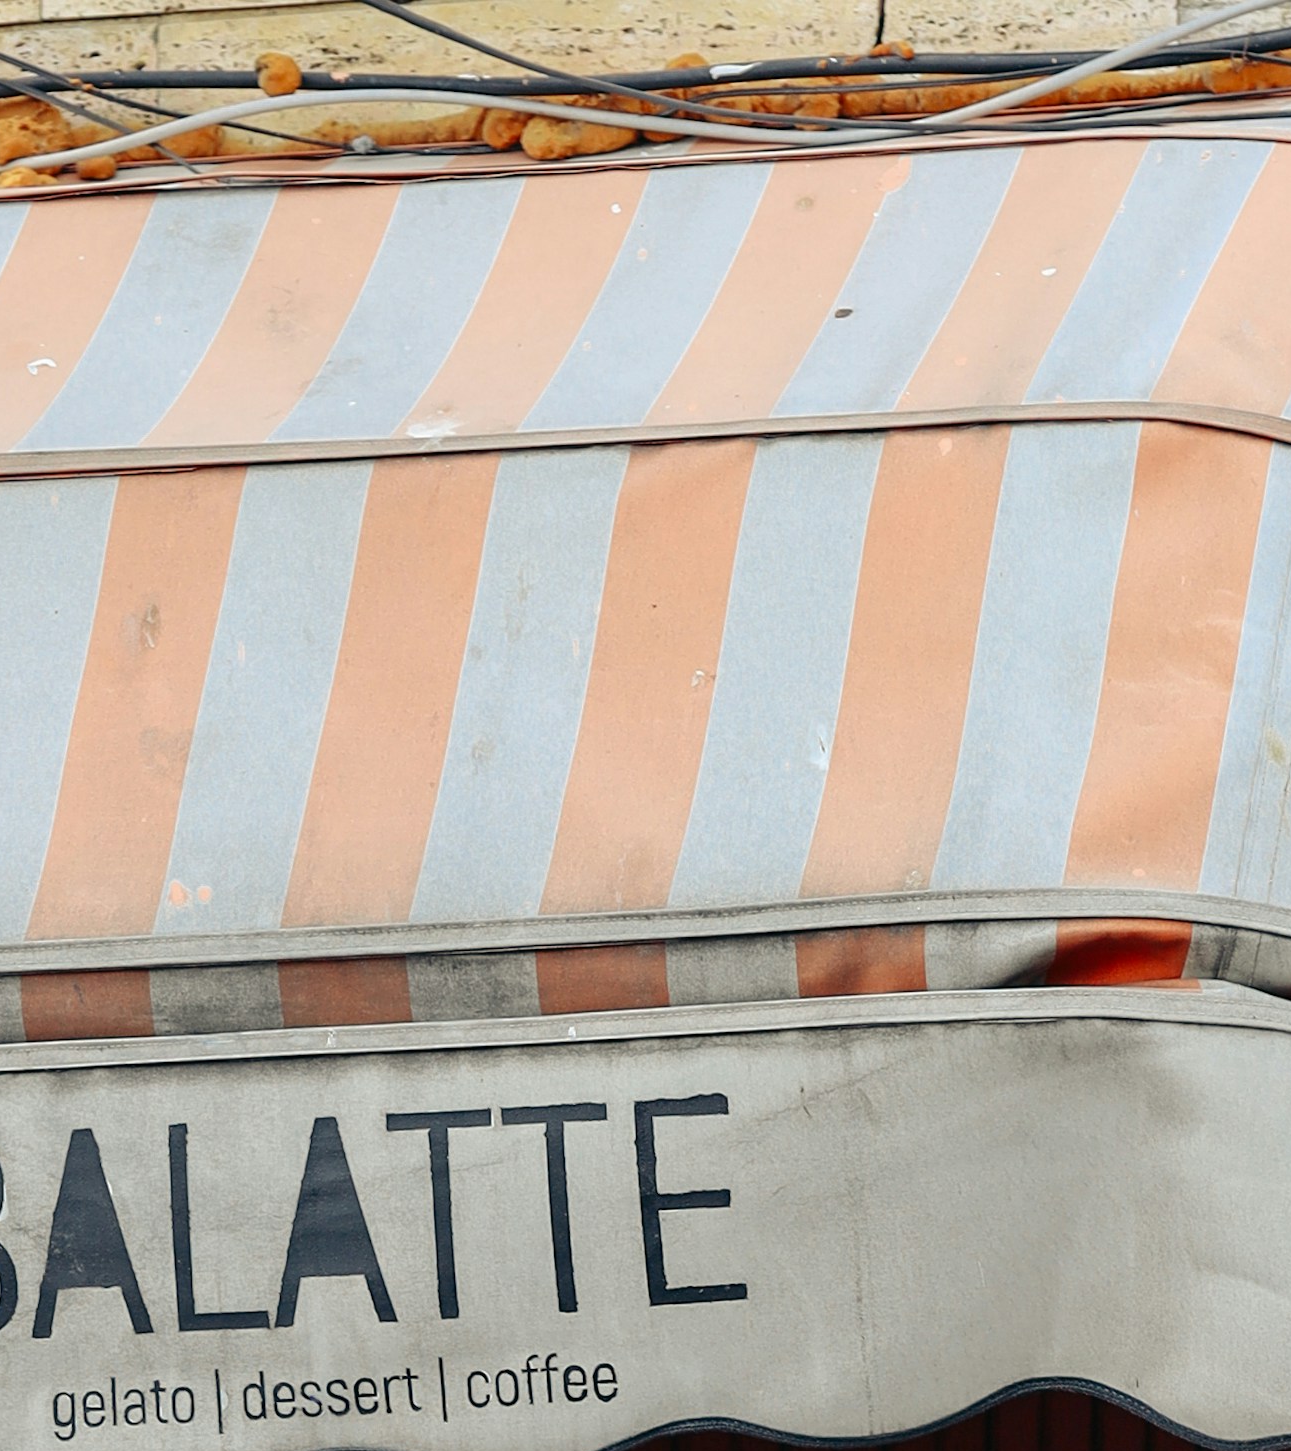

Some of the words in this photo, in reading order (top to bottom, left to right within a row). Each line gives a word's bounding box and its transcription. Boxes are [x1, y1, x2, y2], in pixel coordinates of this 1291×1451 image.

[53, 1377, 195, 1440] gelato
[243, 1367, 422, 1420] dessert
[466, 1353, 619, 1409] coffee
